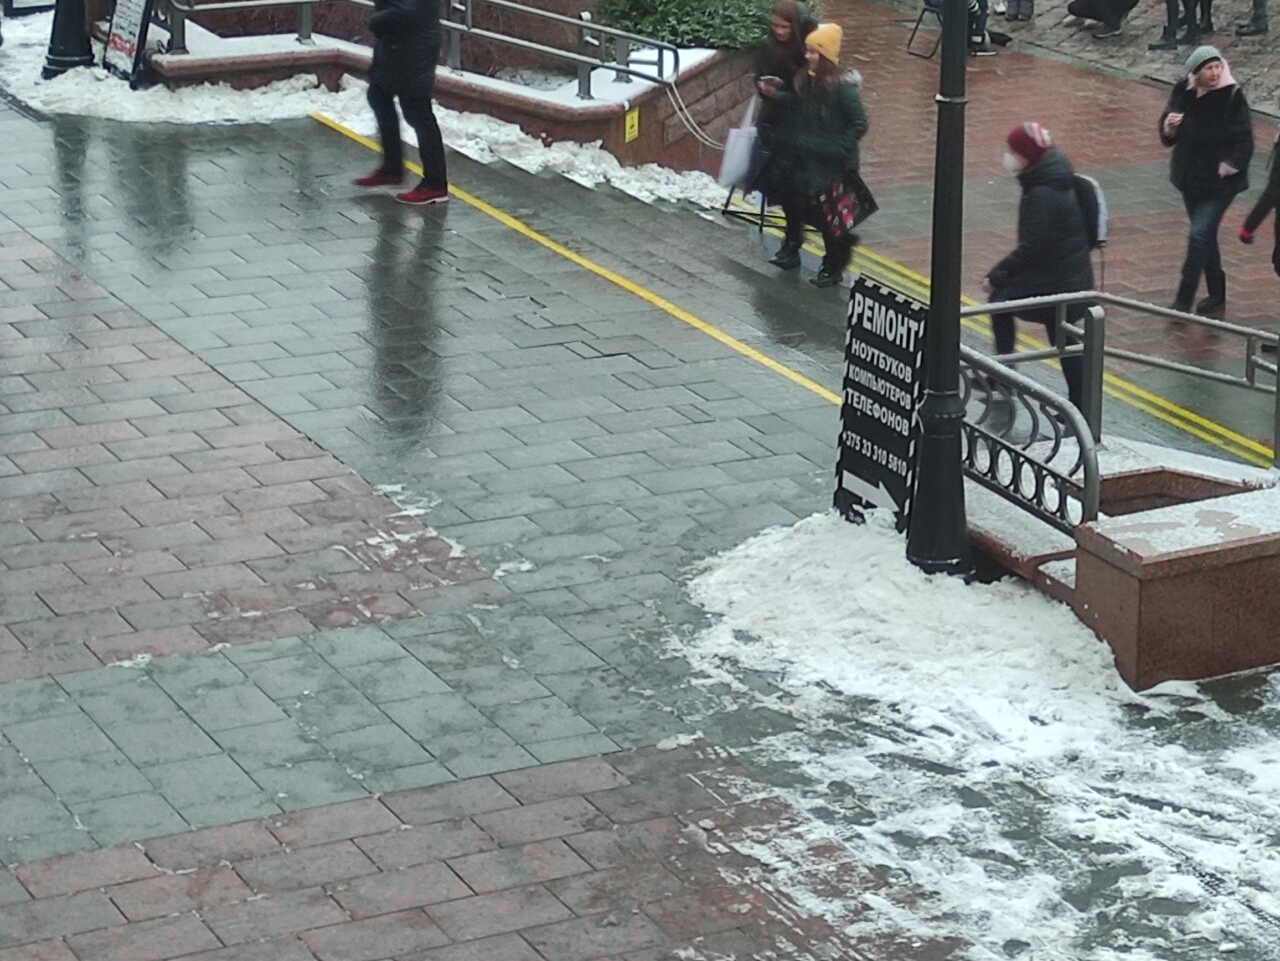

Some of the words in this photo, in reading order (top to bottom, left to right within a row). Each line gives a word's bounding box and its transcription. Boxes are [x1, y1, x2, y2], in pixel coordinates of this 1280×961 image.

[852, 292, 918, 353] РЕМОНТ
[851, 338, 913, 384] НОУТБУКОВ
[848, 364, 911, 410] КОМПЬЮТЕРОВ
[847, 387, 910, 437] ТЕЛЕФОНОВ
[842, 430, 861, 451] +375
[862, 438, 872, 458] 33
[873, 445, 887, 467] 310
